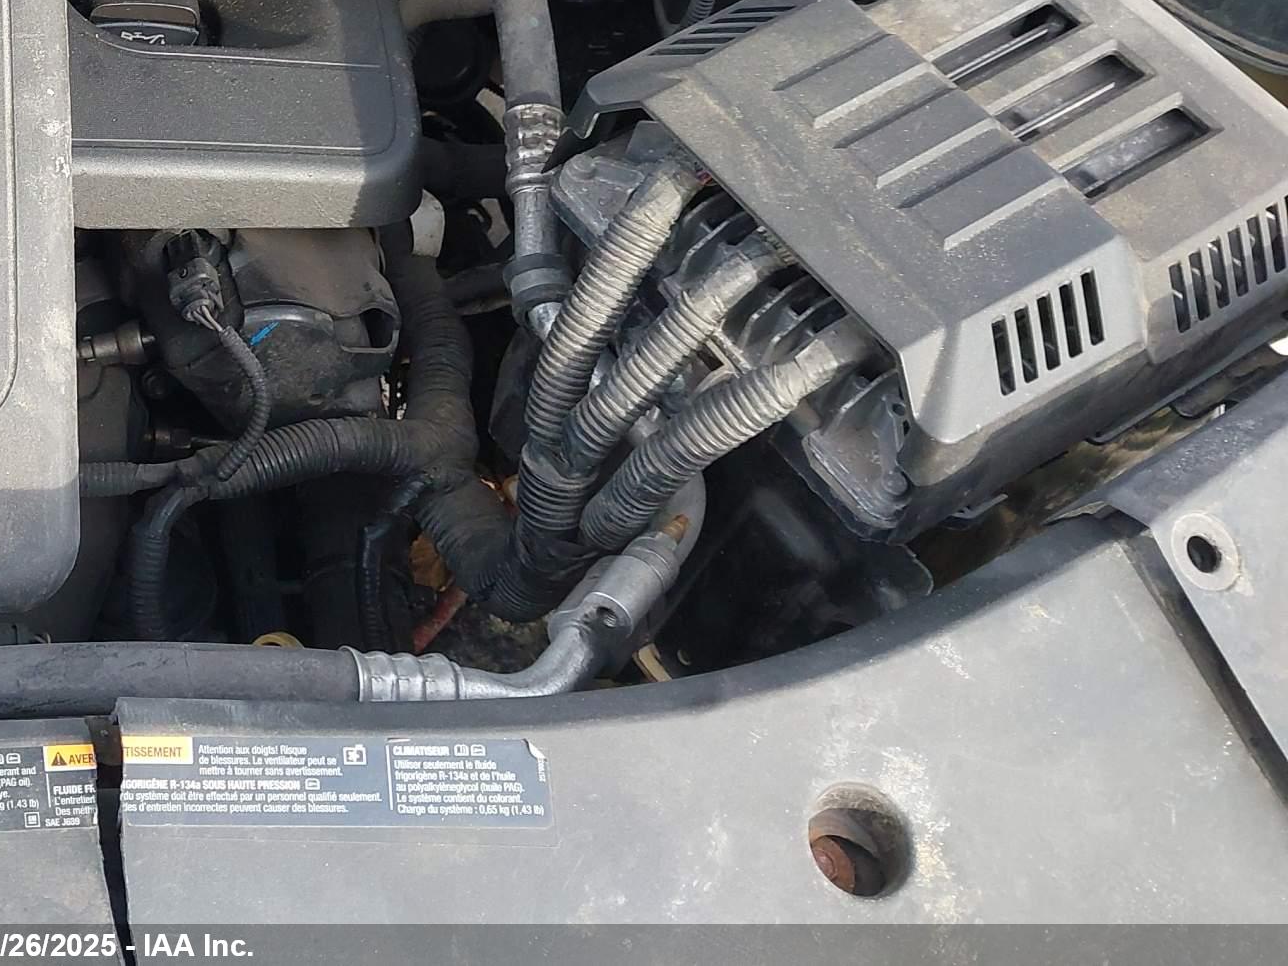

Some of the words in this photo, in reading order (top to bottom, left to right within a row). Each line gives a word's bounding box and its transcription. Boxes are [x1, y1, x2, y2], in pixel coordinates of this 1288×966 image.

[125, 746, 182, 757] TISSEMENT
[199, 745, 233, 754] Attention
[235, 747, 249, 755] aux
[252, 745, 278, 757] doigts!
[280, 746, 307, 757] Risque
[393, 746, 449, 756] CLIMATISEUR
[199, 756, 208, 765] de
[210, 756, 251, 765] blessures.
[253, 757, 263, 765] Le
[264, 756, 305, 765] ventilateur
[308, 757, 326, 767] peut
[328, 758, 337, 766] se
[394, 760, 421, 769] Utiliser
[423, 760, 463, 769] seulement
[466, 760, 473, 769] le
[475, 760, 496, 770] fluide
[21, 766, 36, 775] and
[200, 767, 225, 775] mettre
[227, 766, 233, 775] à
[235, 767, 263, 776] tourner
[265, 768, 284, 776] sans
[286, 767, 343, 776] avertissement.
[396, 771, 437, 781] frigorigène
[439, 771, 468, 780] R-134a
[470, 772, 478, 780] et
[480, 771, 490, 780] de
[492, 771, 516, 780] l'huile
[19, 777, 32, 787] oil).
[170, 780, 200, 789] R-134a
[203, 780, 226, 790] SOUS
[228, 780, 256, 790] HAUTE
[258, 780, 300, 790] PRESSION
[54, 785, 83, 795] FLUIDE
[123, 792, 133, 801] du
[136, 791, 169, 802] système
[171, 792, 186, 801] doit
[188, 791, 203, 801] être
[206, 792, 238, 801] effectué
[240, 793, 253, 803] par
[255, 793, 265, 801] un
[267, 792, 306, 803] personnel
[308, 792, 337, 803] qualifié
[340, 792, 381, 802] seulement.
[397, 794, 407, 802] Le
[409, 794, 441, 804] système
[444, 794, 475, 803] contient
[477, 794, 487, 803] du
[489, 794, 523, 803] colorant.
[7, 801, 28, 811] (1.43
[30, 799, 39, 809] lb)
[123, 803, 137, 812] des
[139, 803, 182, 812] d'entretien
[184, 803, 228, 812] incorrectes
[230, 804, 261, 814] peuvent
[263, 804, 289, 813] causer
[292, 803, 306, 813] des
[308, 803, 348, 813] blessures.
[56, 807, 70, 816] Des
[45, 818, 60, 827] SAE
